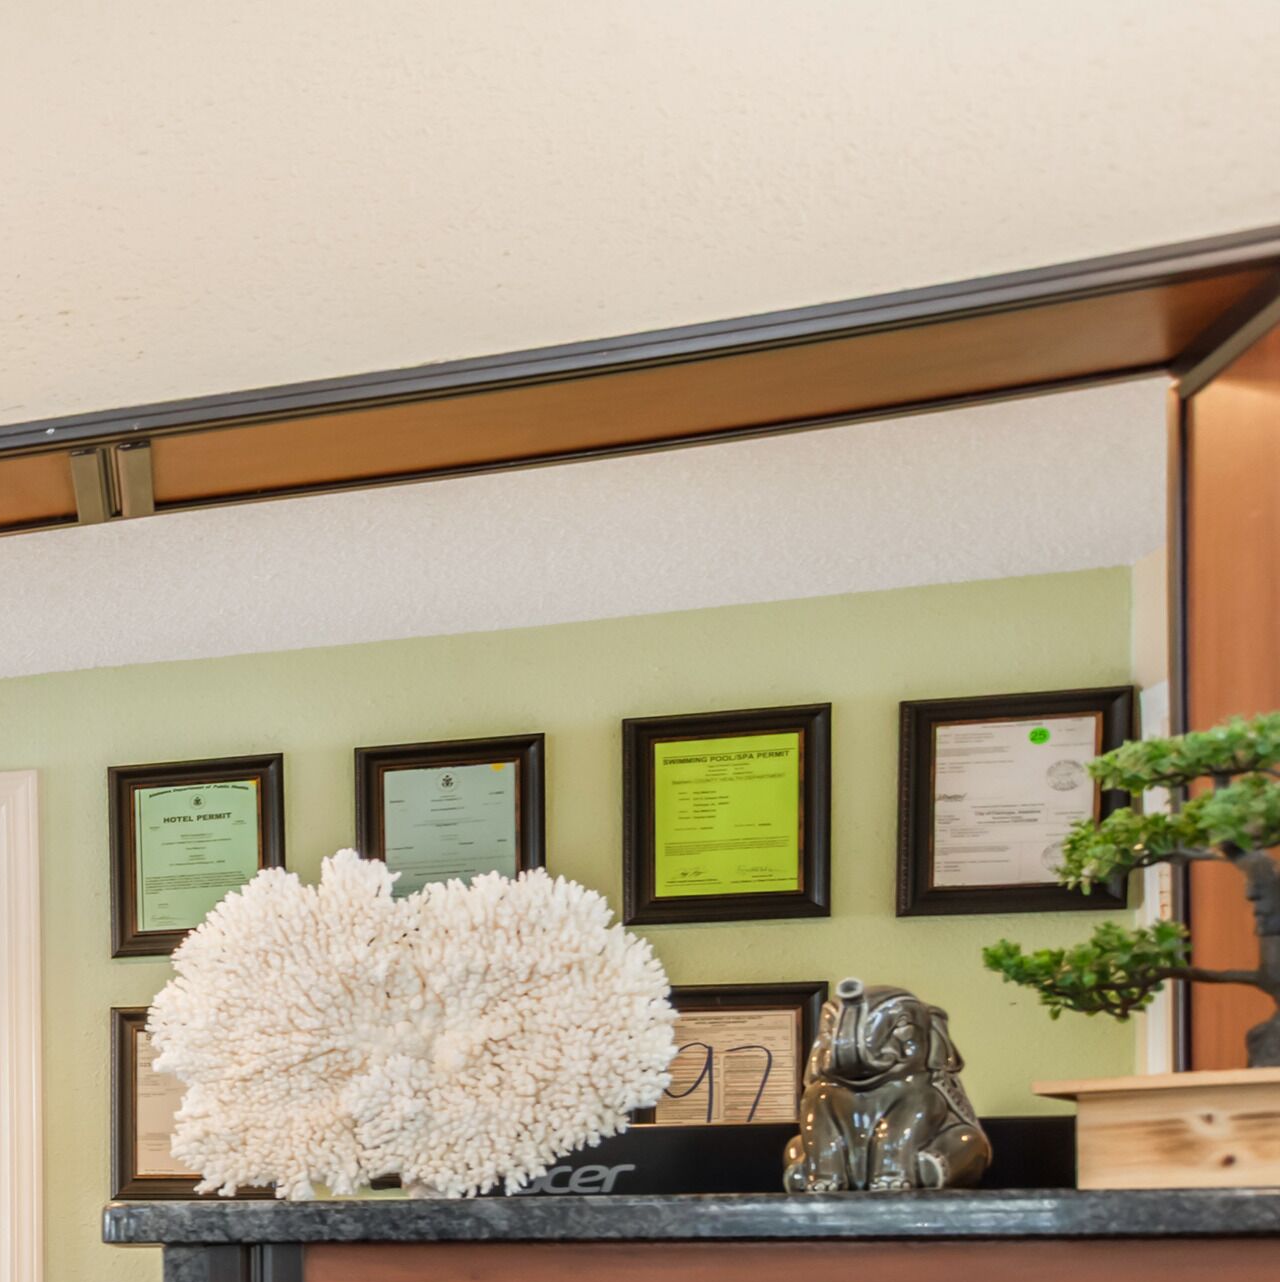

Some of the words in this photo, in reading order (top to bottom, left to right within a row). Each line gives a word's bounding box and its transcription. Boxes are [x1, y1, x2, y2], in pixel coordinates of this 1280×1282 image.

[663, 757, 708, 766] SWIMMING
[709, 753, 754, 763] POOL/SPA
[756, 750, 790, 759] PERMIT
[163, 815, 193, 823] HOTEL
[196, 812, 231, 820] PERMIT
